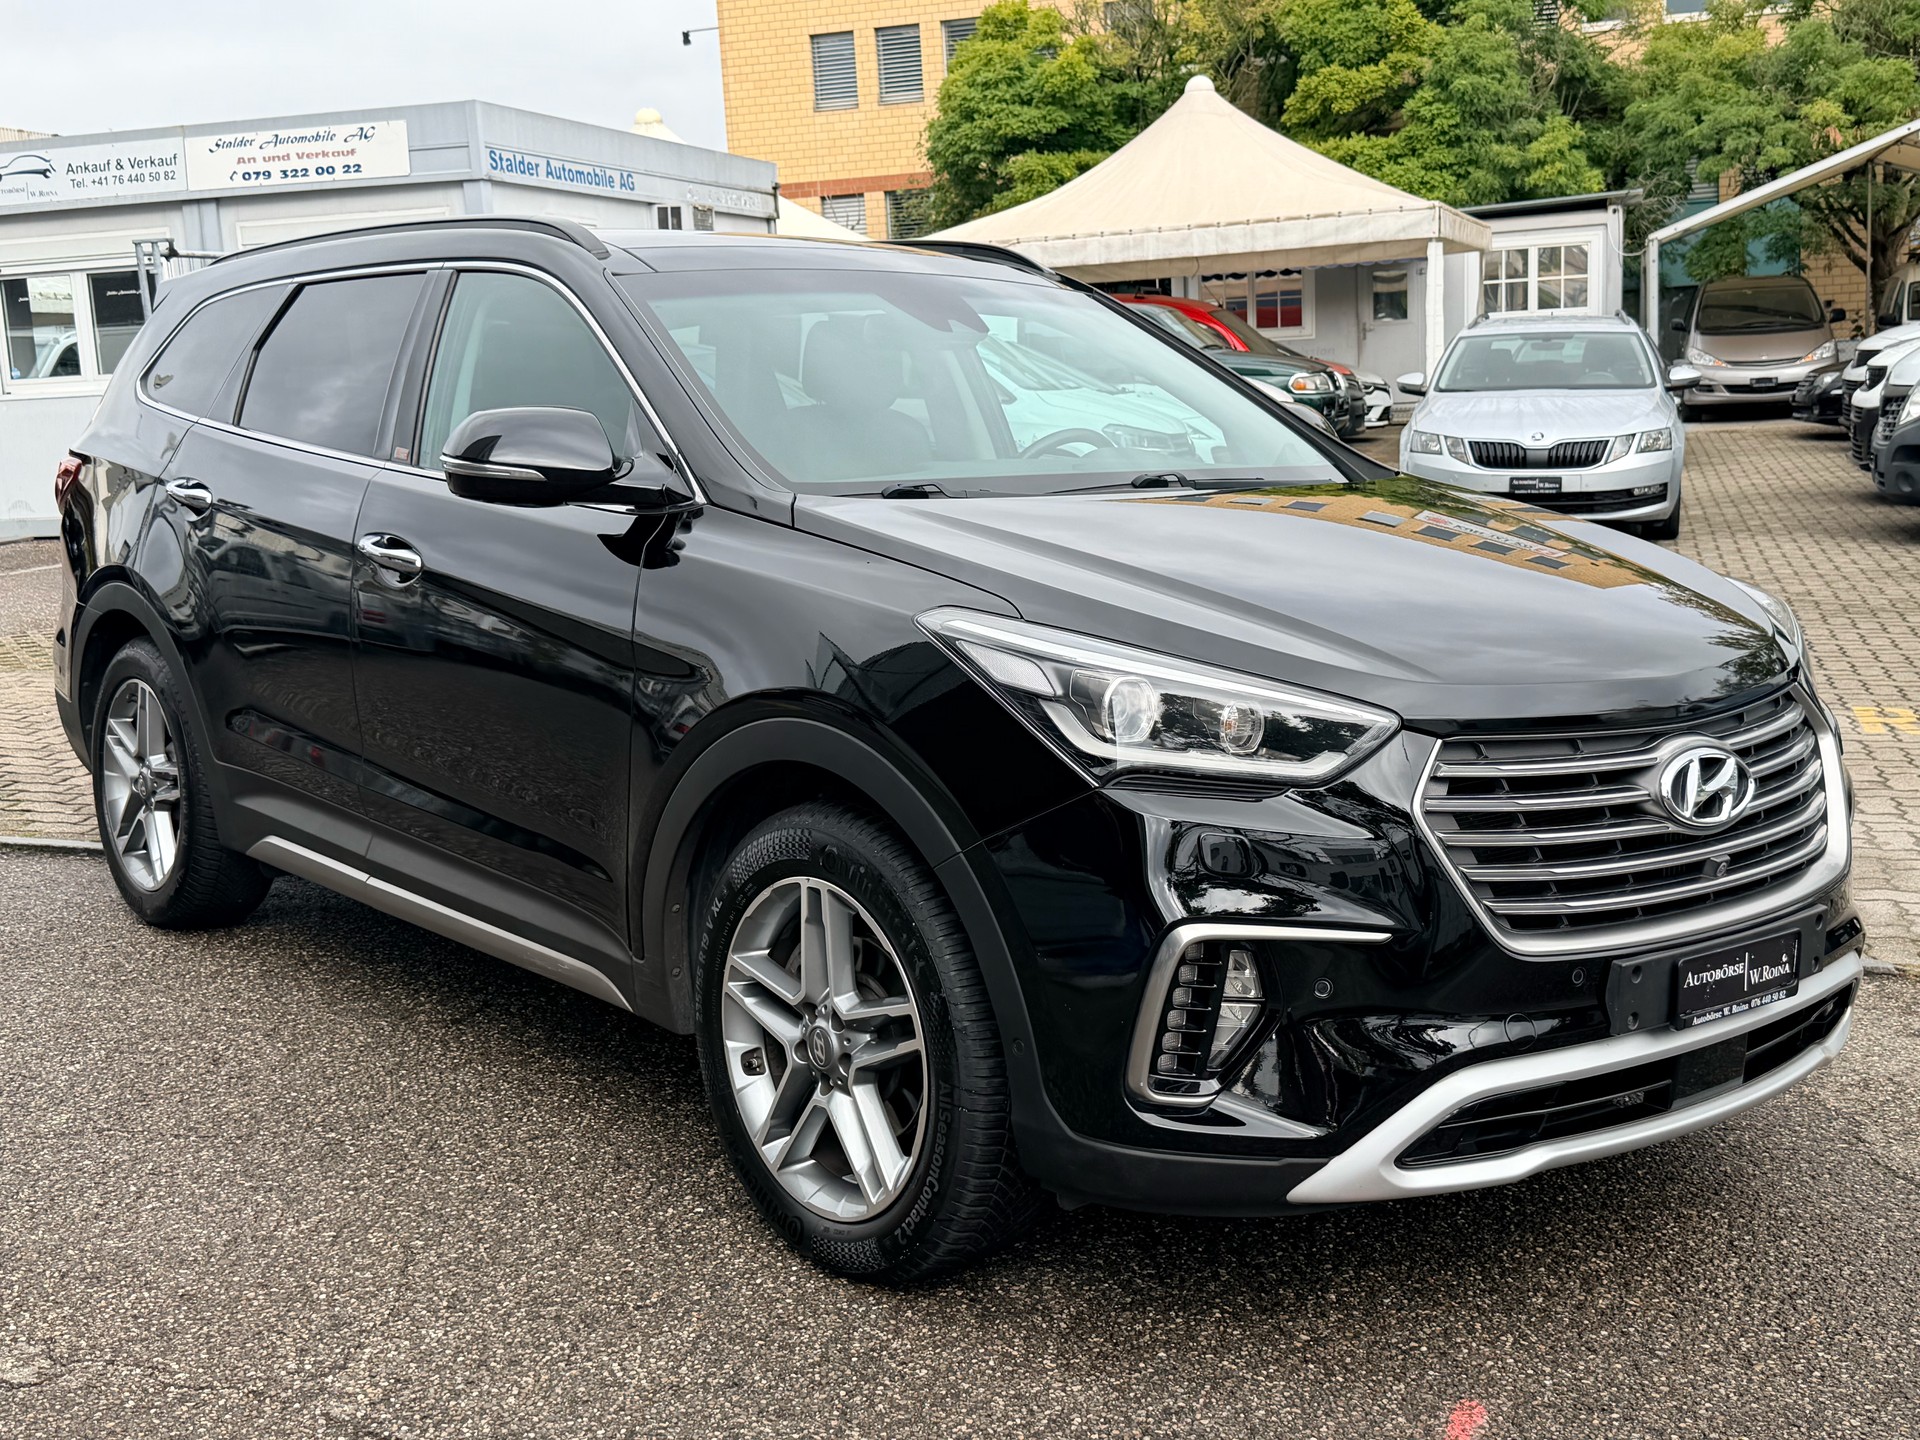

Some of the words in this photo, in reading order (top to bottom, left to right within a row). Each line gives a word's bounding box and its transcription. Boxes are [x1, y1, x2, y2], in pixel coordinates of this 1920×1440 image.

[208, 137, 255, 153] Stalder
[259, 131, 336, 150] Automobile
[344, 126, 376, 143] AG
[66, 159, 111, 175] Ankauf
[115, 159, 124, 171] &
[128, 153, 178, 170] Verkauf
[236, 156, 257, 165] An
[263, 153, 291, 163] und
[295, 148, 356, 160] Verkauf
[70, 177, 88, 189] Tel.
[91, 175, 108, 187] +41
[112, 175, 124, 185] 76
[127, 172, 145, 183] 440
[149, 171, 161, 182] 50
[164, 170, 176, 181] 82
[242, 170, 272, 181] 079
[280, 167, 310, 179] 322
[315, 165, 336, 176] 00
[342, 163, 362, 174] 22
[489, 150, 539, 177] Stalder
[546, 160, 615, 189] Automobile
[619, 172, 635, 191] AG
[1692, 1011, 1722, 1025] Autobörse
